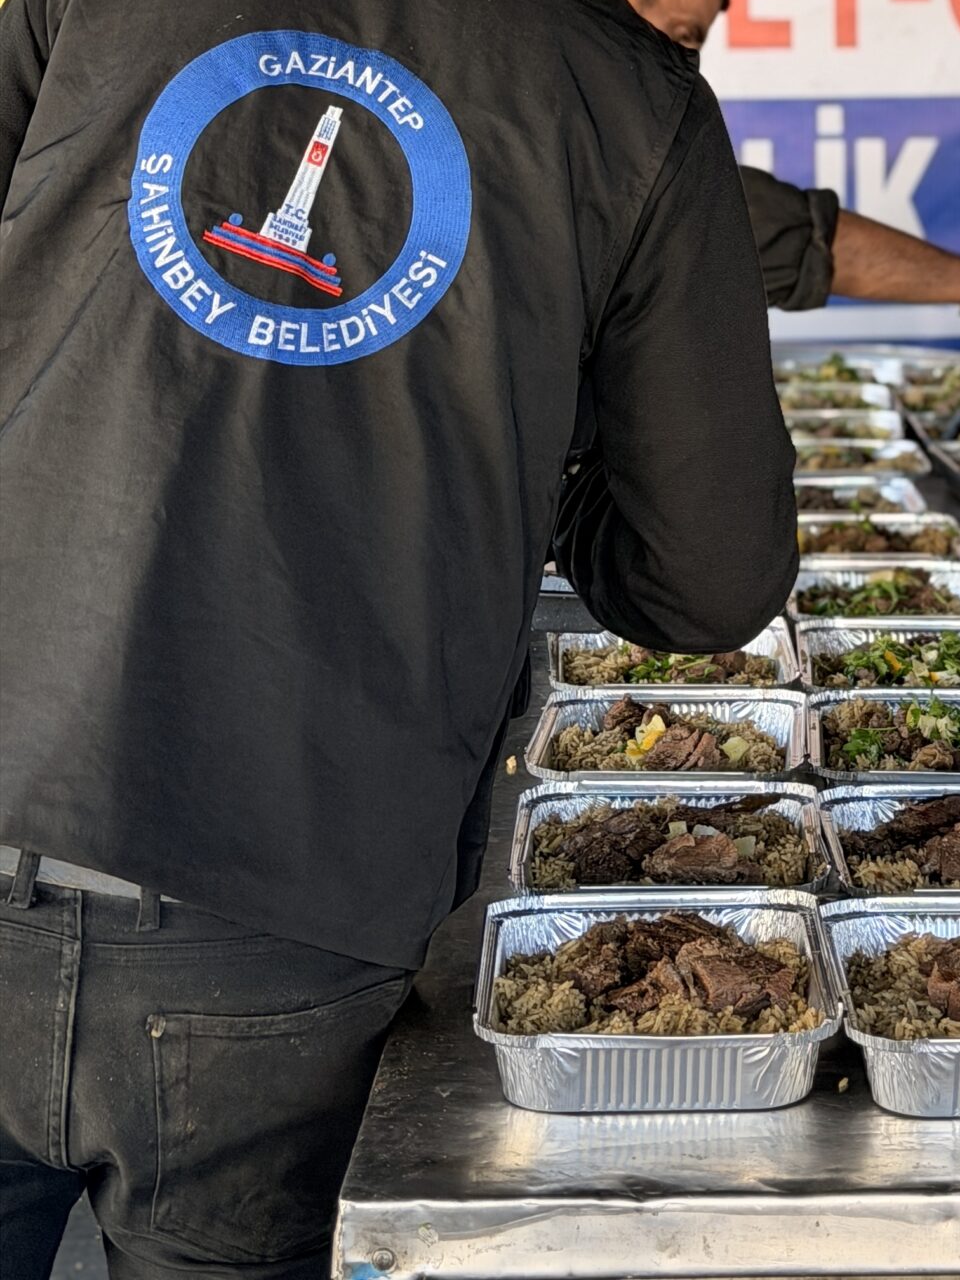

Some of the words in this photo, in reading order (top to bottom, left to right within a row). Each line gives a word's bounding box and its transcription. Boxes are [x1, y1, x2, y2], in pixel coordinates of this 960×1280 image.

[259, 51, 424, 131] GAZİANTEP
[140, 153, 237, 324] ŞAHİNBEY
[247, 250, 448, 353] BELEDİYESİ
[285, 204, 306, 222] T.C.
